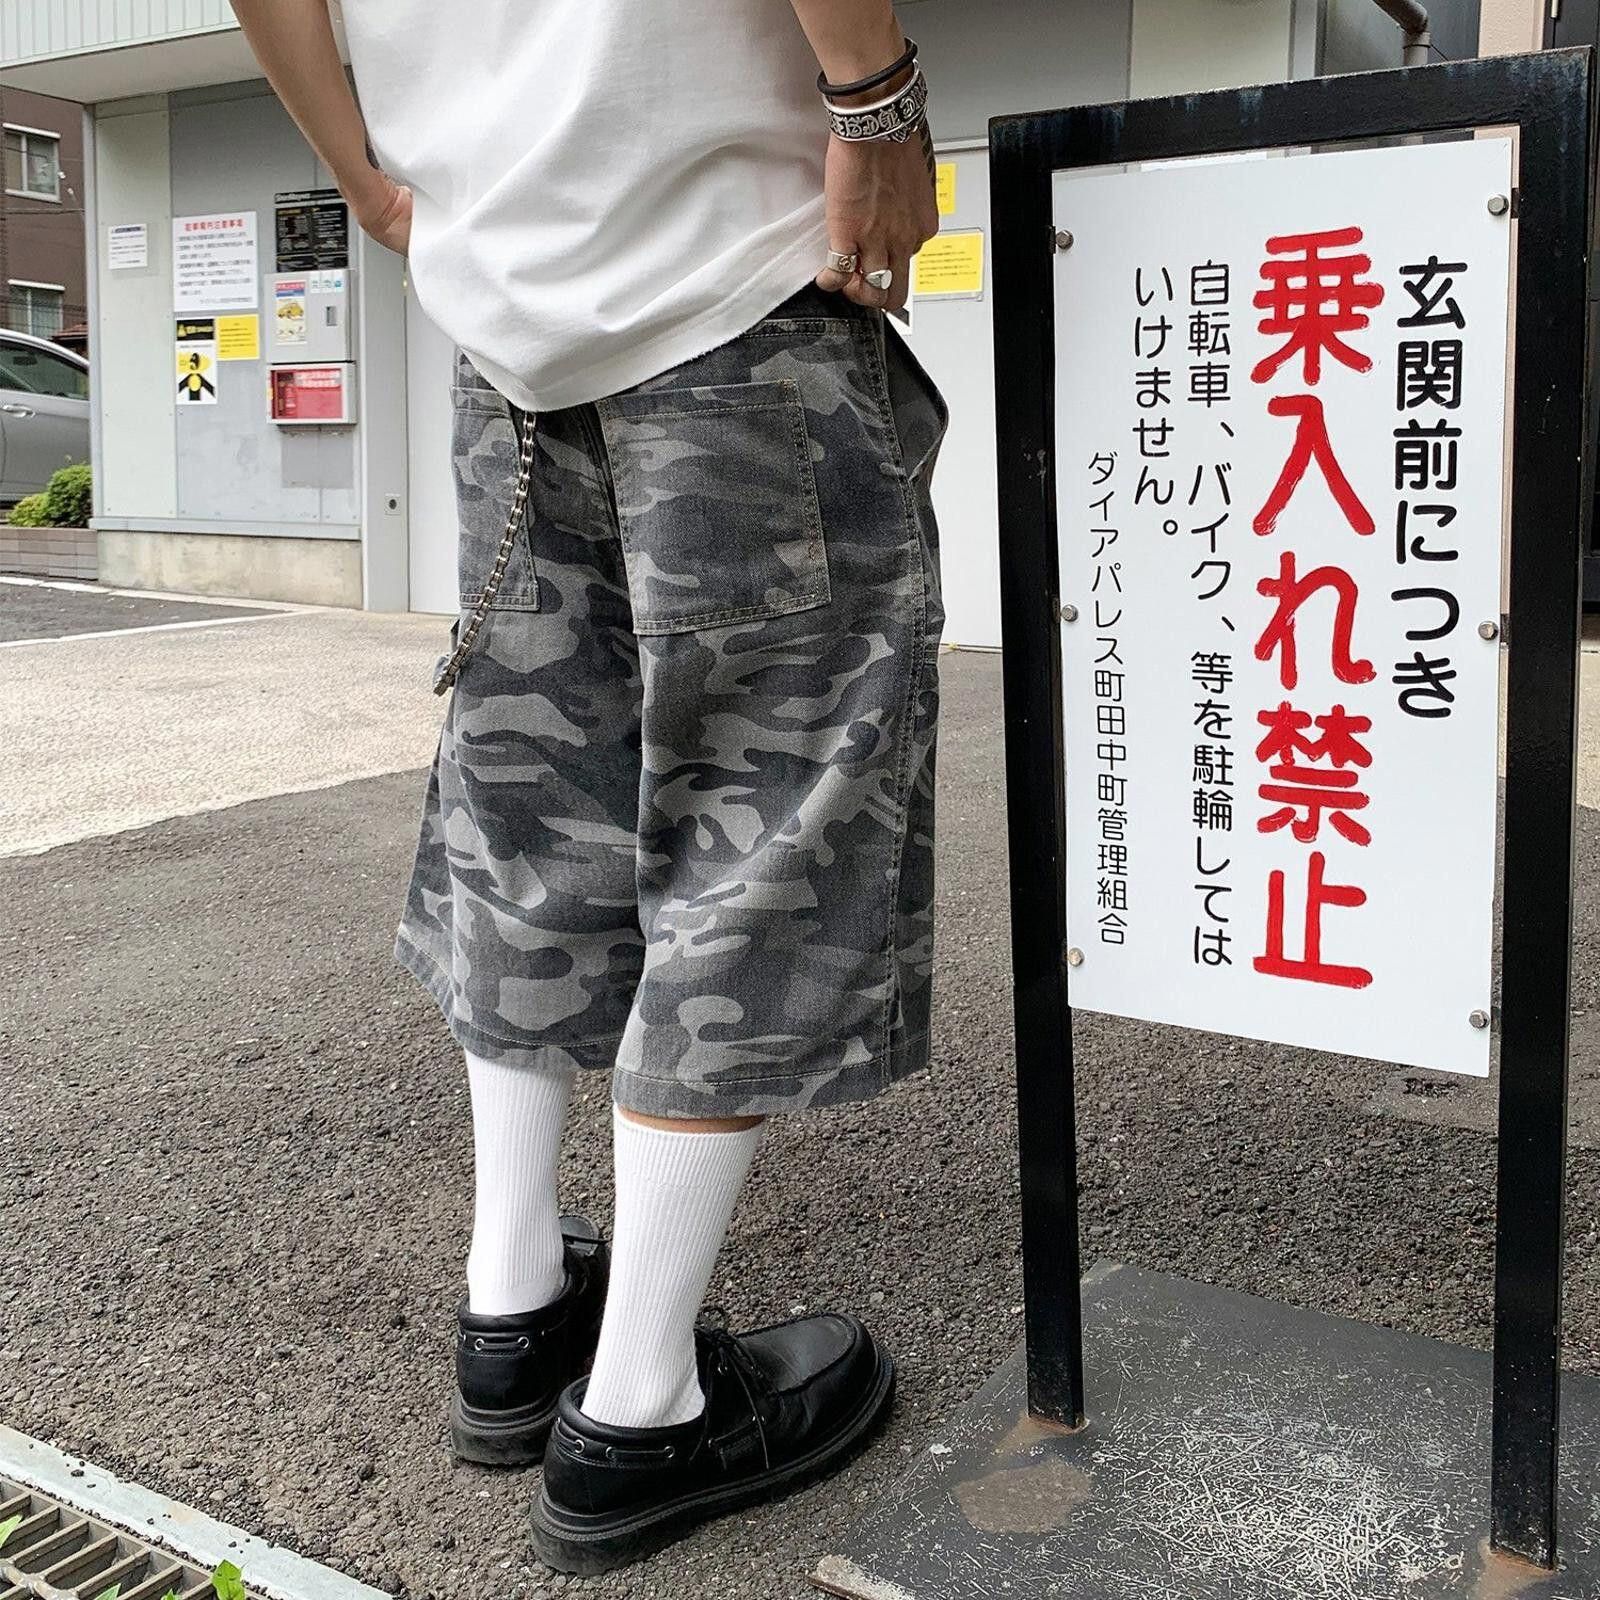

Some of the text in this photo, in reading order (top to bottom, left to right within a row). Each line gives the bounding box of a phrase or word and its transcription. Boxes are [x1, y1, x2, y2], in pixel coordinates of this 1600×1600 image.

[1132, 266, 1177, 536] いけません。
[1188, 259, 1235, 966] 自転車、バイク、等を駐輪しては
[1250, 226, 1384, 990] 乗入れ禁止
[1391, 255, 1467, 718] 玄関前につき
[1088, 451, 1128, 945] ダイアパレス町田中町管理組合
